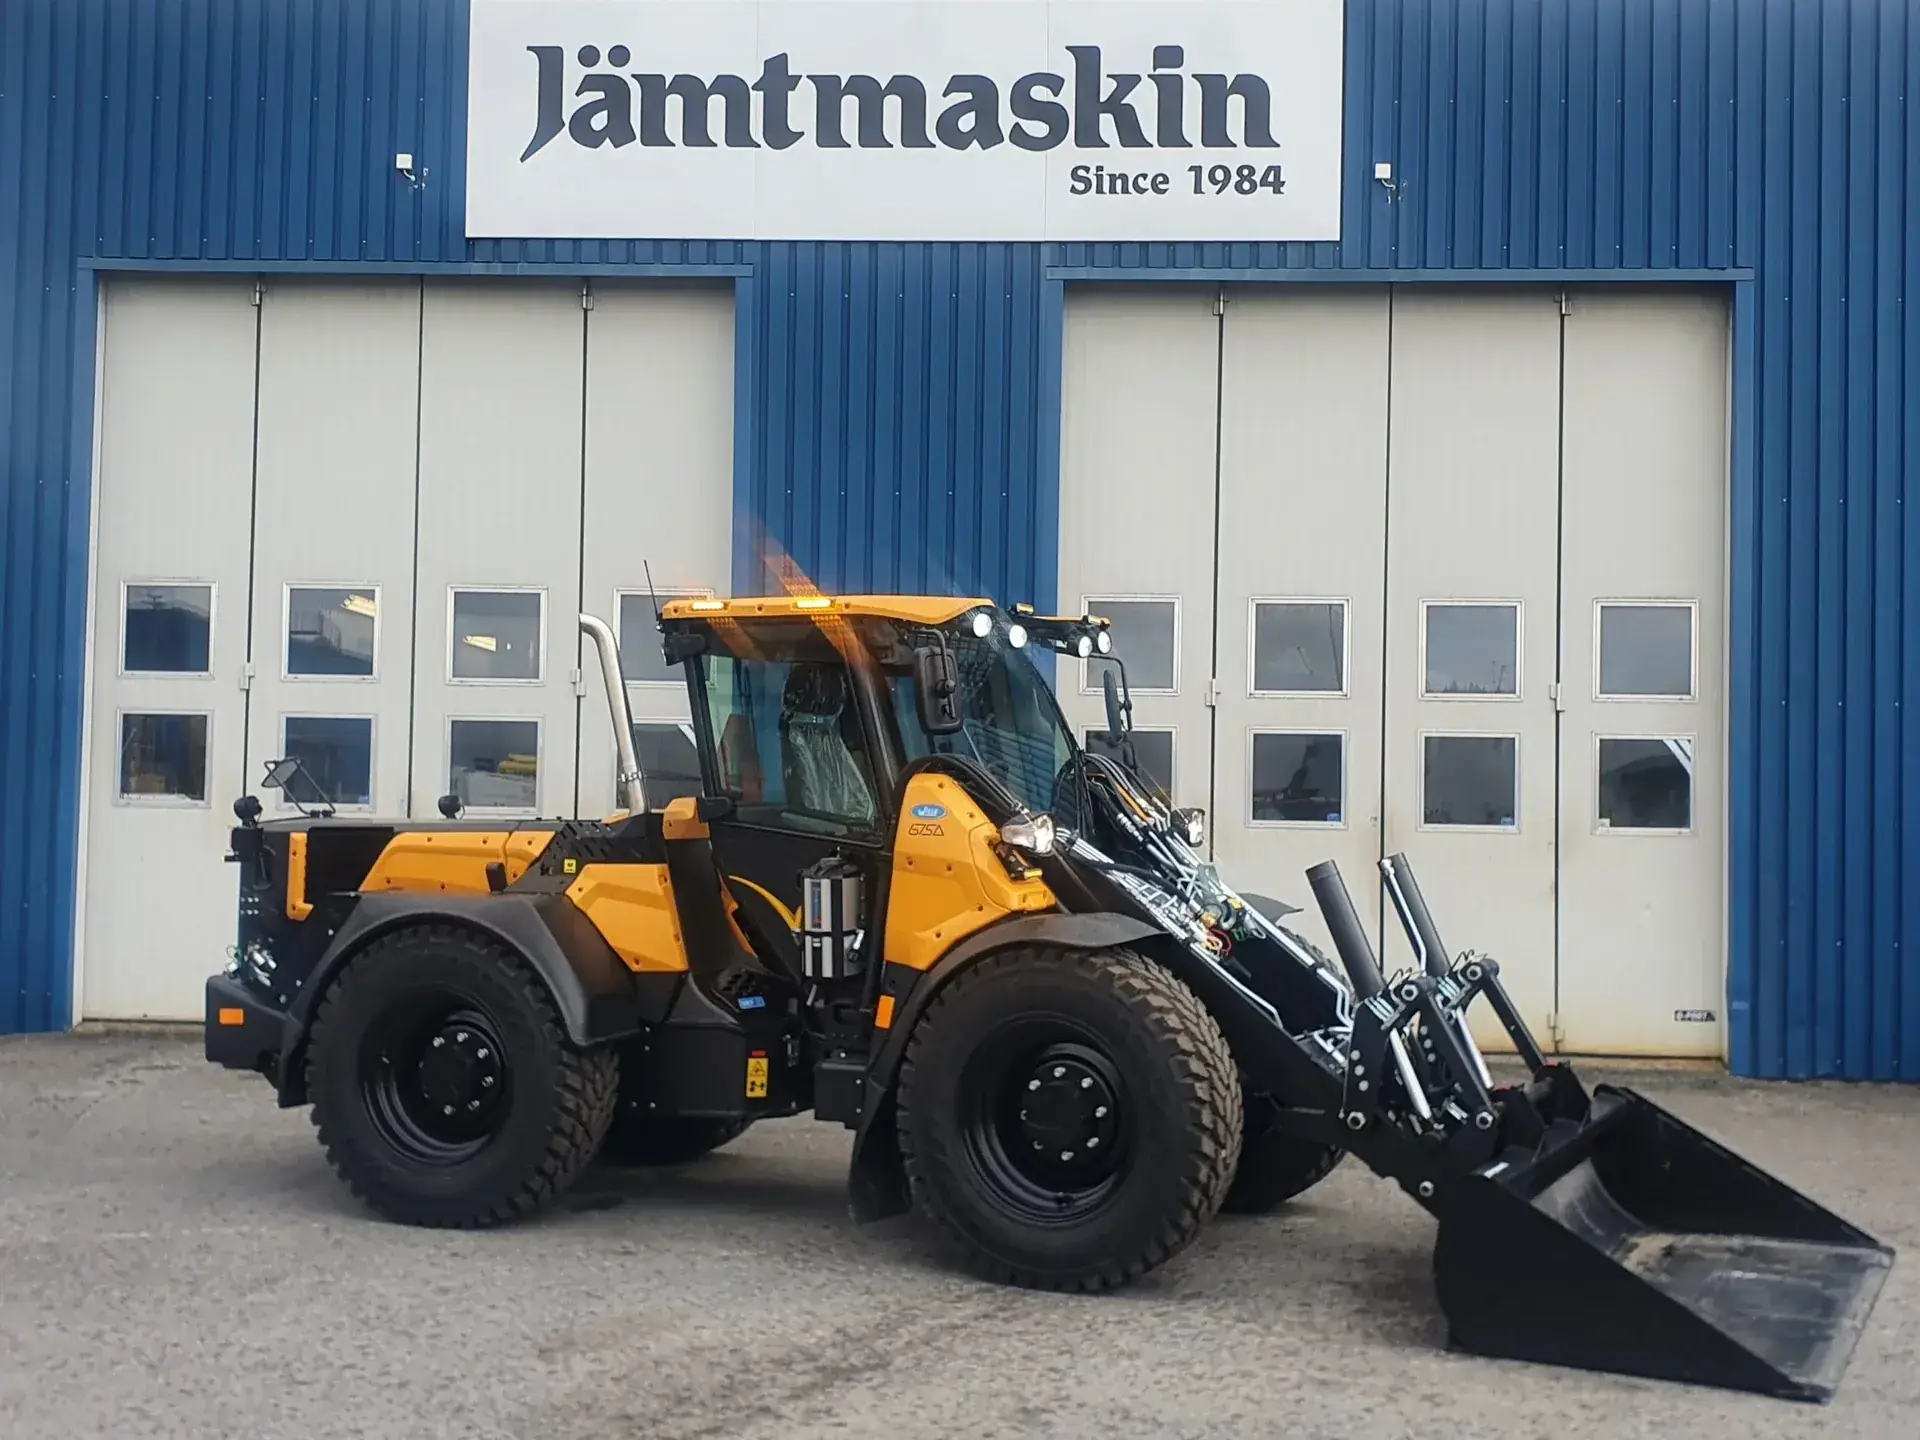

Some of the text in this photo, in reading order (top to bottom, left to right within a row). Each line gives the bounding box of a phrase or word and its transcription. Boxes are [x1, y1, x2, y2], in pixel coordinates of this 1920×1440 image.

[519, 44, 1281, 164] Jämtmaskin
[1070, 165, 1286, 196] Since 1984
